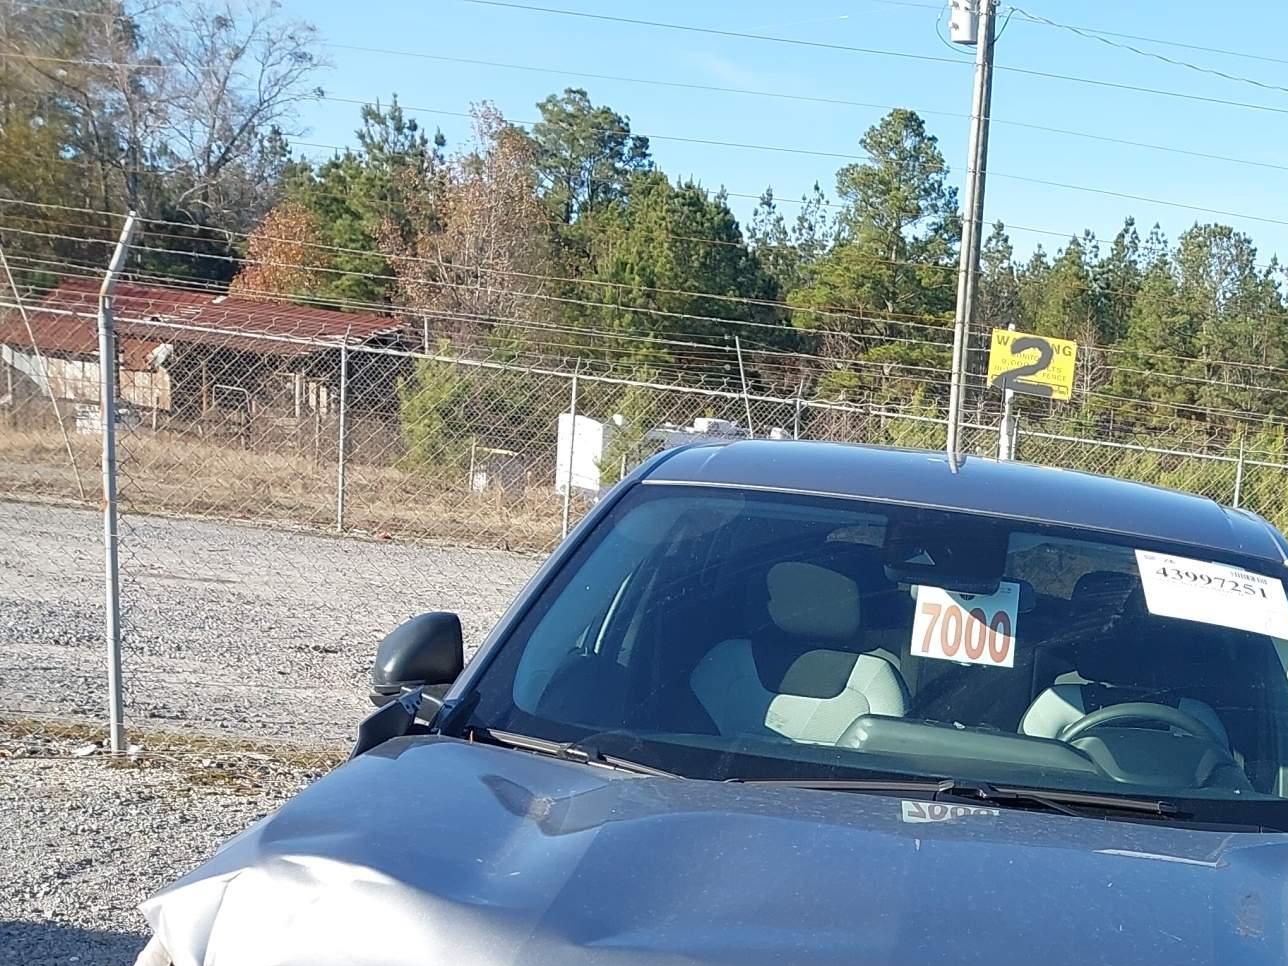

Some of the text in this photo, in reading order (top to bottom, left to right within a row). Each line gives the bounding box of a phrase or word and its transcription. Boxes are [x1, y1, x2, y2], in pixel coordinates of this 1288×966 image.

[992, 336, 1054, 397] 2
[1156, 566, 1268, 599] 43997251
[921, 602, 1012, 664] 7000
